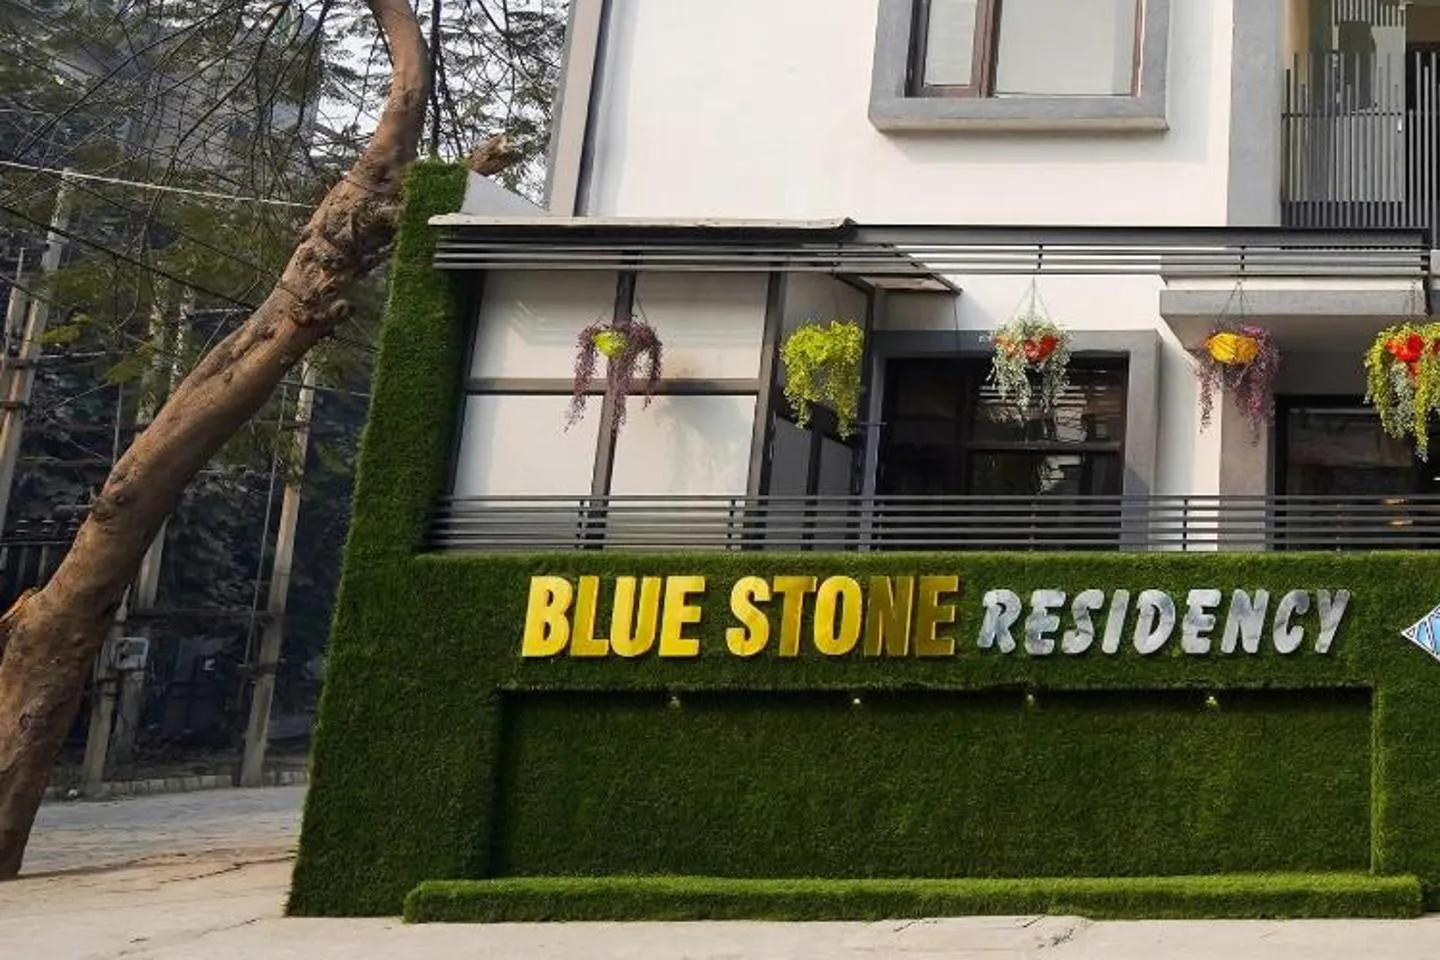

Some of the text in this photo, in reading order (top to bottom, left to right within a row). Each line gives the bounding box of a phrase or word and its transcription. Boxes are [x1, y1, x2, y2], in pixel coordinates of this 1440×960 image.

[521, 575, 1351, 658] BLUE STONE RESIDENCY
